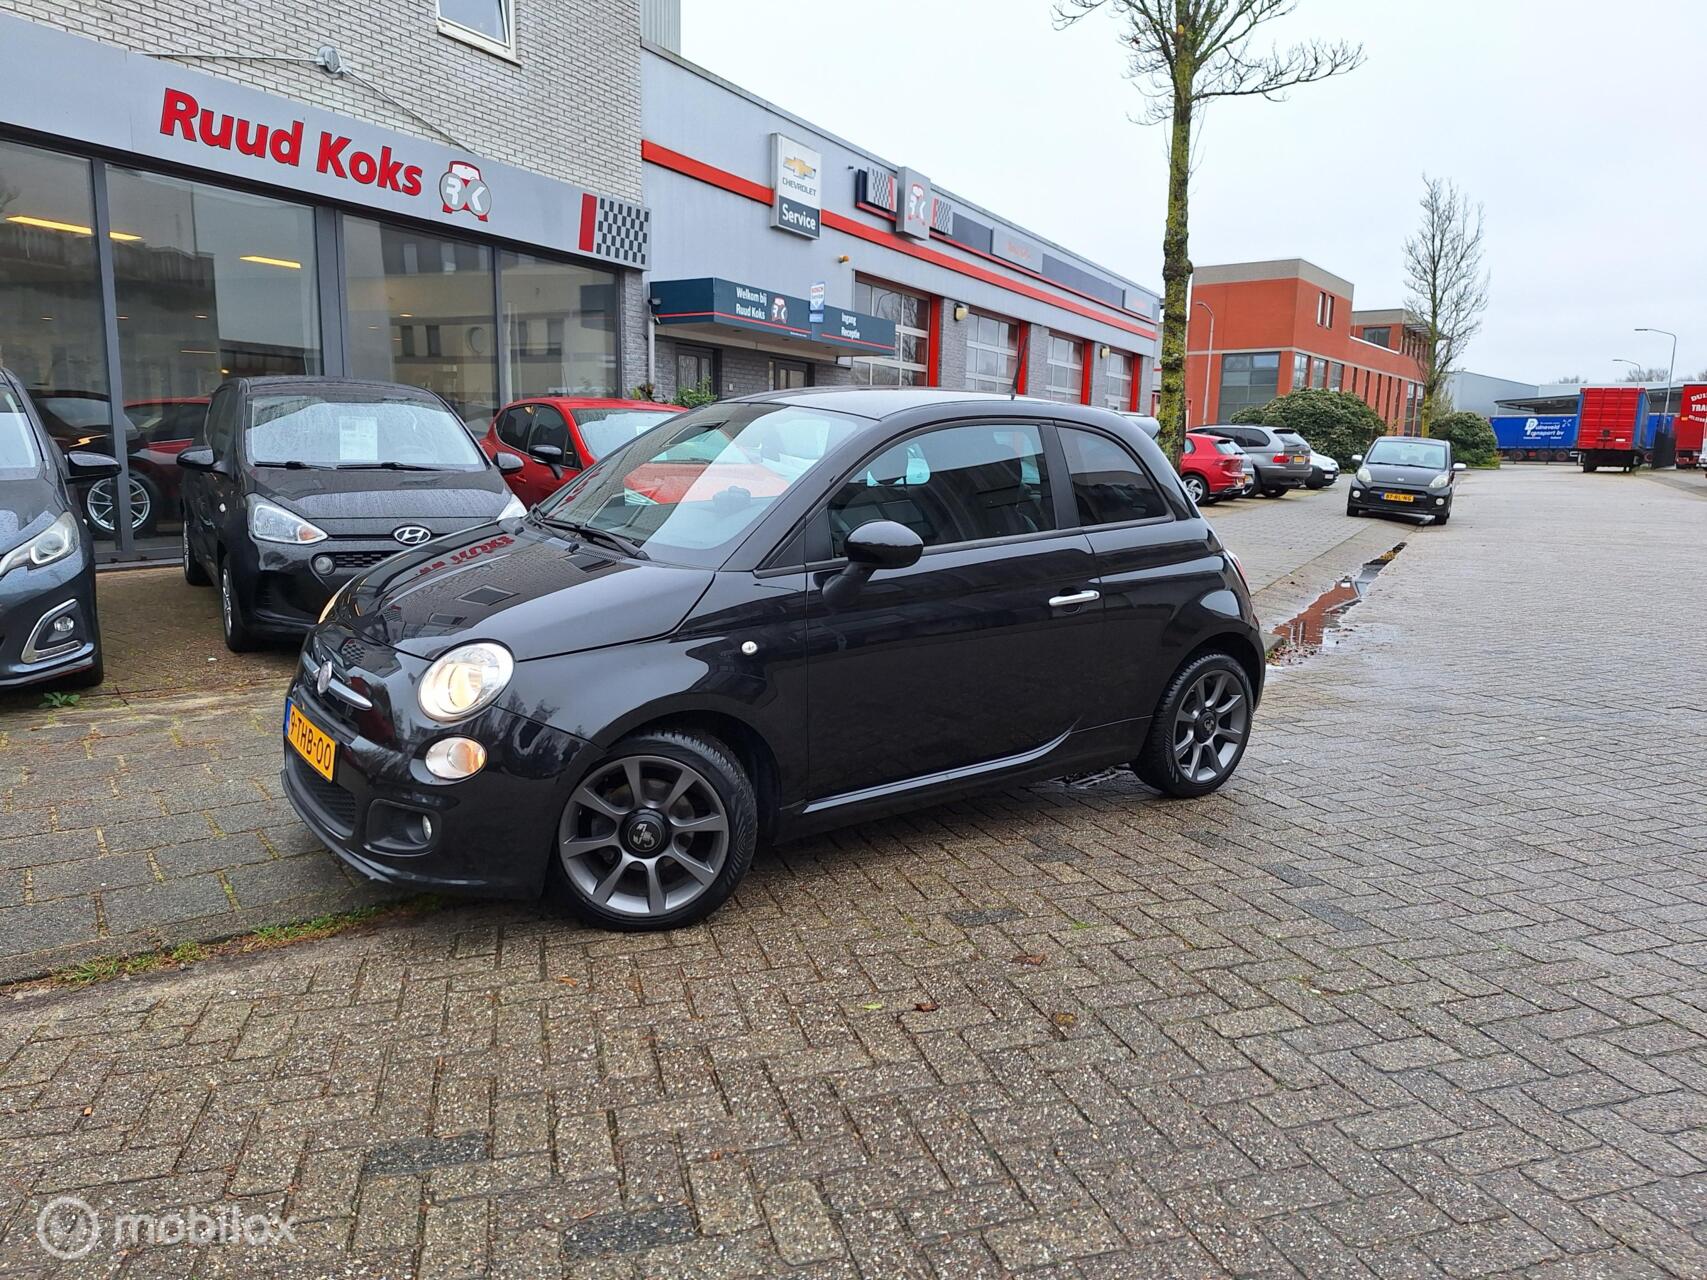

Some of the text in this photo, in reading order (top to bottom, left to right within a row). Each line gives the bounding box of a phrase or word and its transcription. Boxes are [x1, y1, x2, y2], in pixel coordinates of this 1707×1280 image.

[160, 87, 423, 197] Ruud Koks
[782, 177, 816, 196] CHEVROLET
[782, 203, 816, 230] Service
[736, 287, 760, 302] Welkom
[735, 304, 766, 320] Ruud Koks
